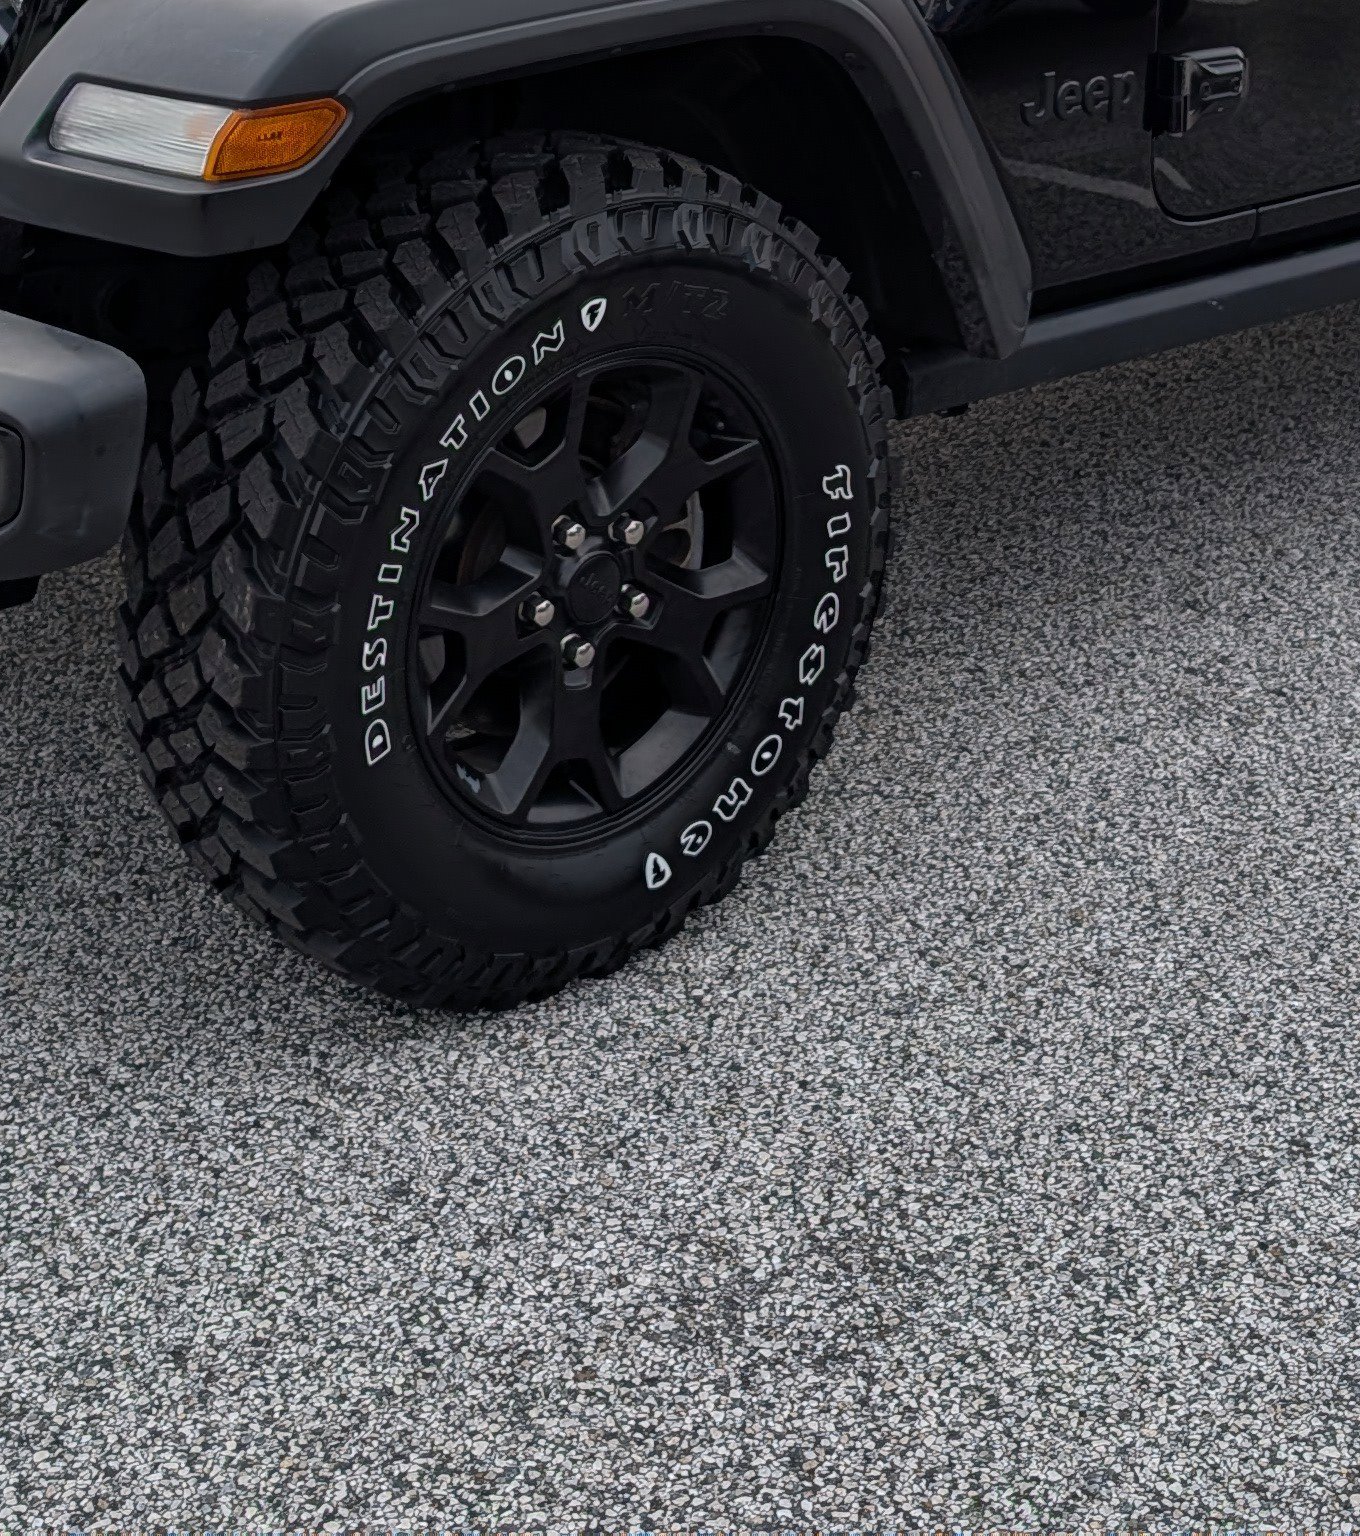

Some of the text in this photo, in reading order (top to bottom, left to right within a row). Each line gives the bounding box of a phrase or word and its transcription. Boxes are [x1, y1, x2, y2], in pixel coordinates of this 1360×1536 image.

[1020, 69, 1139, 126] Jeep
[361, 320, 565, 766] DESTINATION
[680, 464, 853, 857] Firestone
